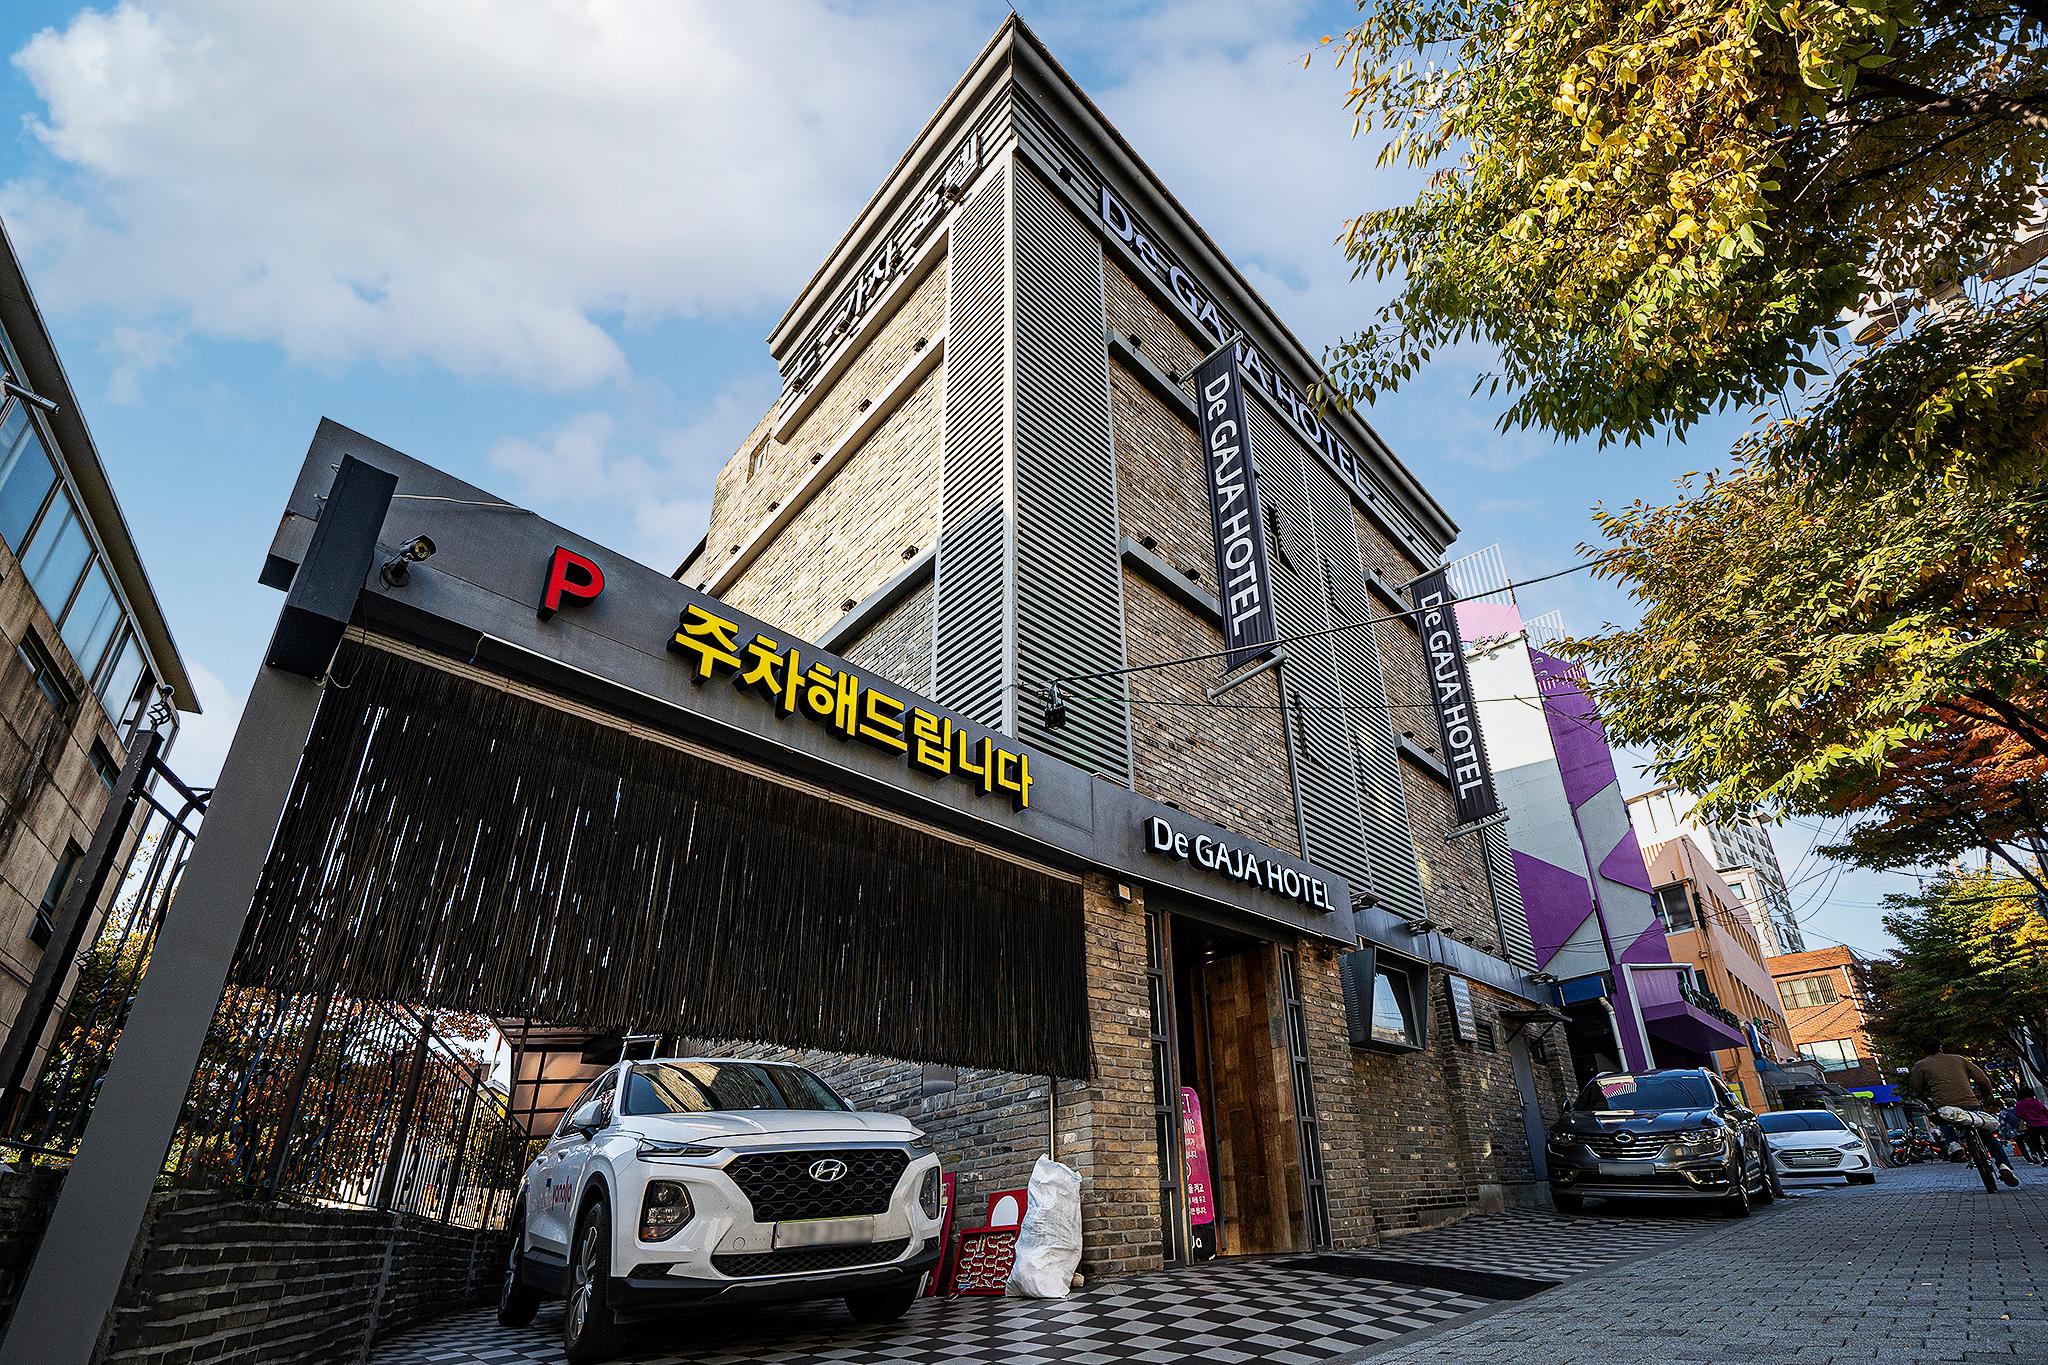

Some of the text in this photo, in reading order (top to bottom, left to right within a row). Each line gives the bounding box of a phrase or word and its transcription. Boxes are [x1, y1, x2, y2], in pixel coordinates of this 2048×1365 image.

[1100, 186, 1160, 273] De
[1273, 372, 1372, 495] HOTEL
[544, 545, 606, 618] P
[1204, 371, 1262, 637] De GAJA HOTEL
[673, 602, 1035, 810] 주차해드립니다
[1420, 591, 1484, 801] De GAJA HOTEL
[1152, 815, 1336, 912] De GAJA HOTEL
